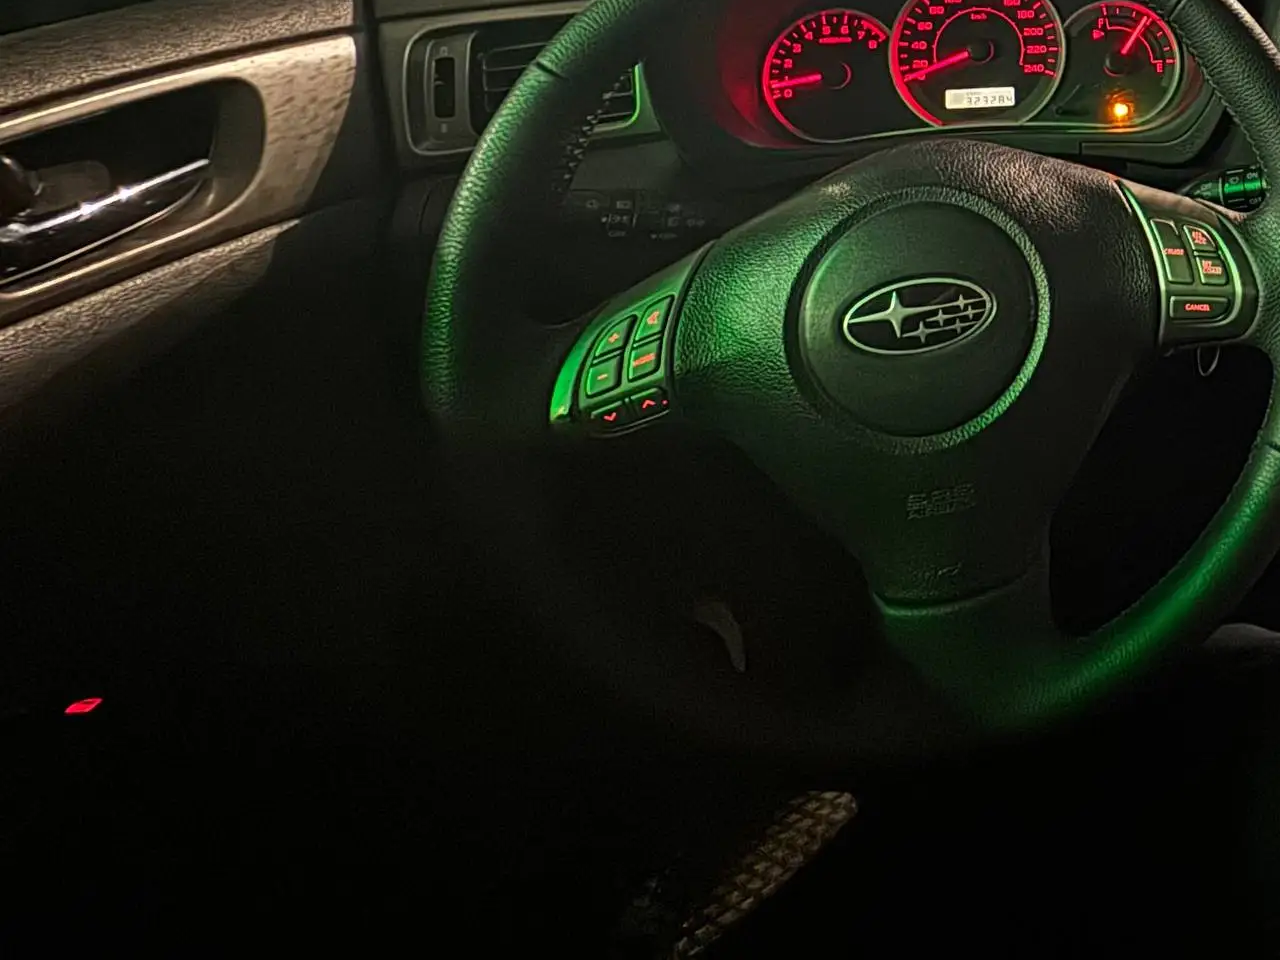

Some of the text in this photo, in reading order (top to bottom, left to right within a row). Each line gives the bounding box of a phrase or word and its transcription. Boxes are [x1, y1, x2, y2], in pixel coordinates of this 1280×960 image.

[929, 6, 945, 15] 80
[1017, 10, 1035, 19] 180
[822, 25, 831, 35] 5
[840, 25, 849, 34] 6
[917, 21, 933, 30] 60
[804, 31, 813, 40] 4
[857, 31, 865, 40] 7
[1023, 27, 1044, 36] 200
[792, 43, 801, 53] 3
[868, 39, 877, 49] 8
[911, 41, 927, 50] 40
[1027, 45, 1047, 54] 220
[784, 58, 793, 68] 2
[912, 60, 929, 69] 20
[1024, 64, 1045, 73] 240
[1156, 63, 1163, 73] E
[784, 89, 792, 98] 0
[1184, 303, 1210, 312] CANCEL
